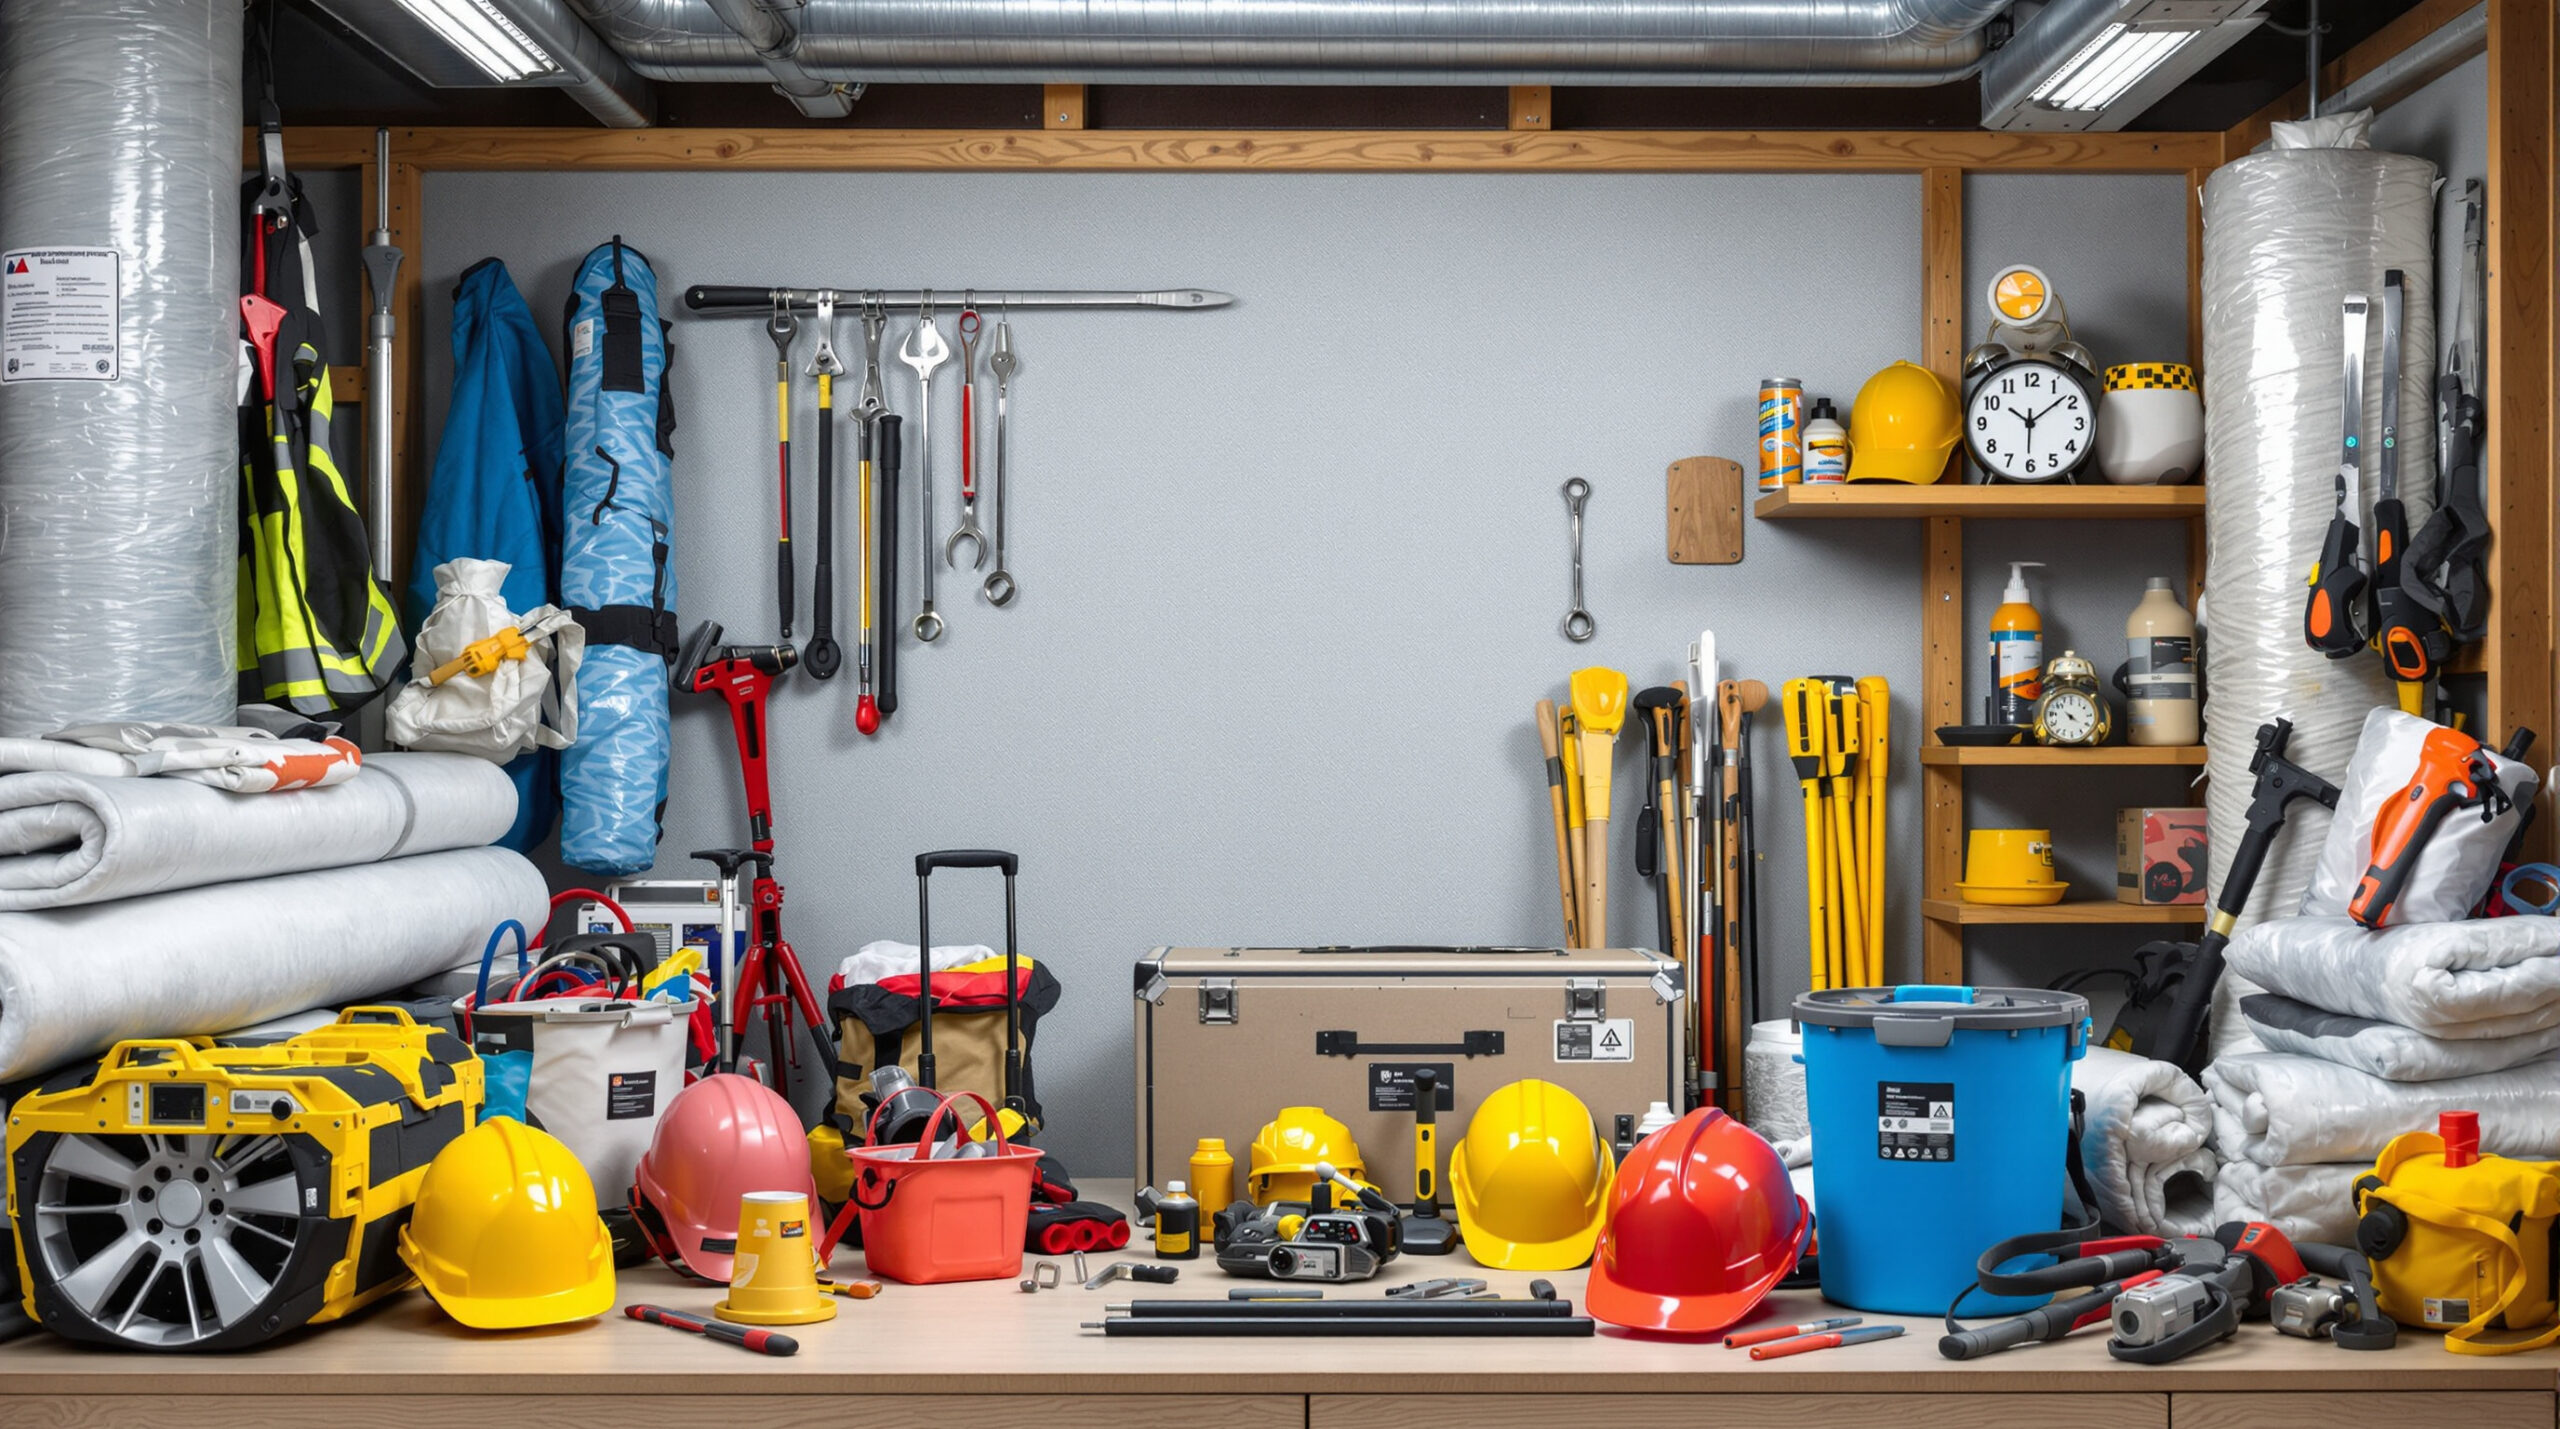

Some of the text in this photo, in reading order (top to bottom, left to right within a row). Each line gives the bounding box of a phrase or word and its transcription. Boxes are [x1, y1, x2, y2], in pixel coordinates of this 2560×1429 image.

[2001, 378, 2015, 394] 11
[2024, 372, 2040, 387] 12
[2051, 379, 2057, 394] 1
[1984, 395, 2000, 411] 10
[2067, 395, 2078, 410] 2
[1977, 416, 1987, 431] 9
[2073, 416, 2084, 431] 3
[1986, 438, 1997, 454] 8
[2065, 439, 2077, 454] 4
[2004, 453, 2014, 468] 7
[2025, 459, 2036, 473] 6
[2048, 453, 2058, 468] 5
